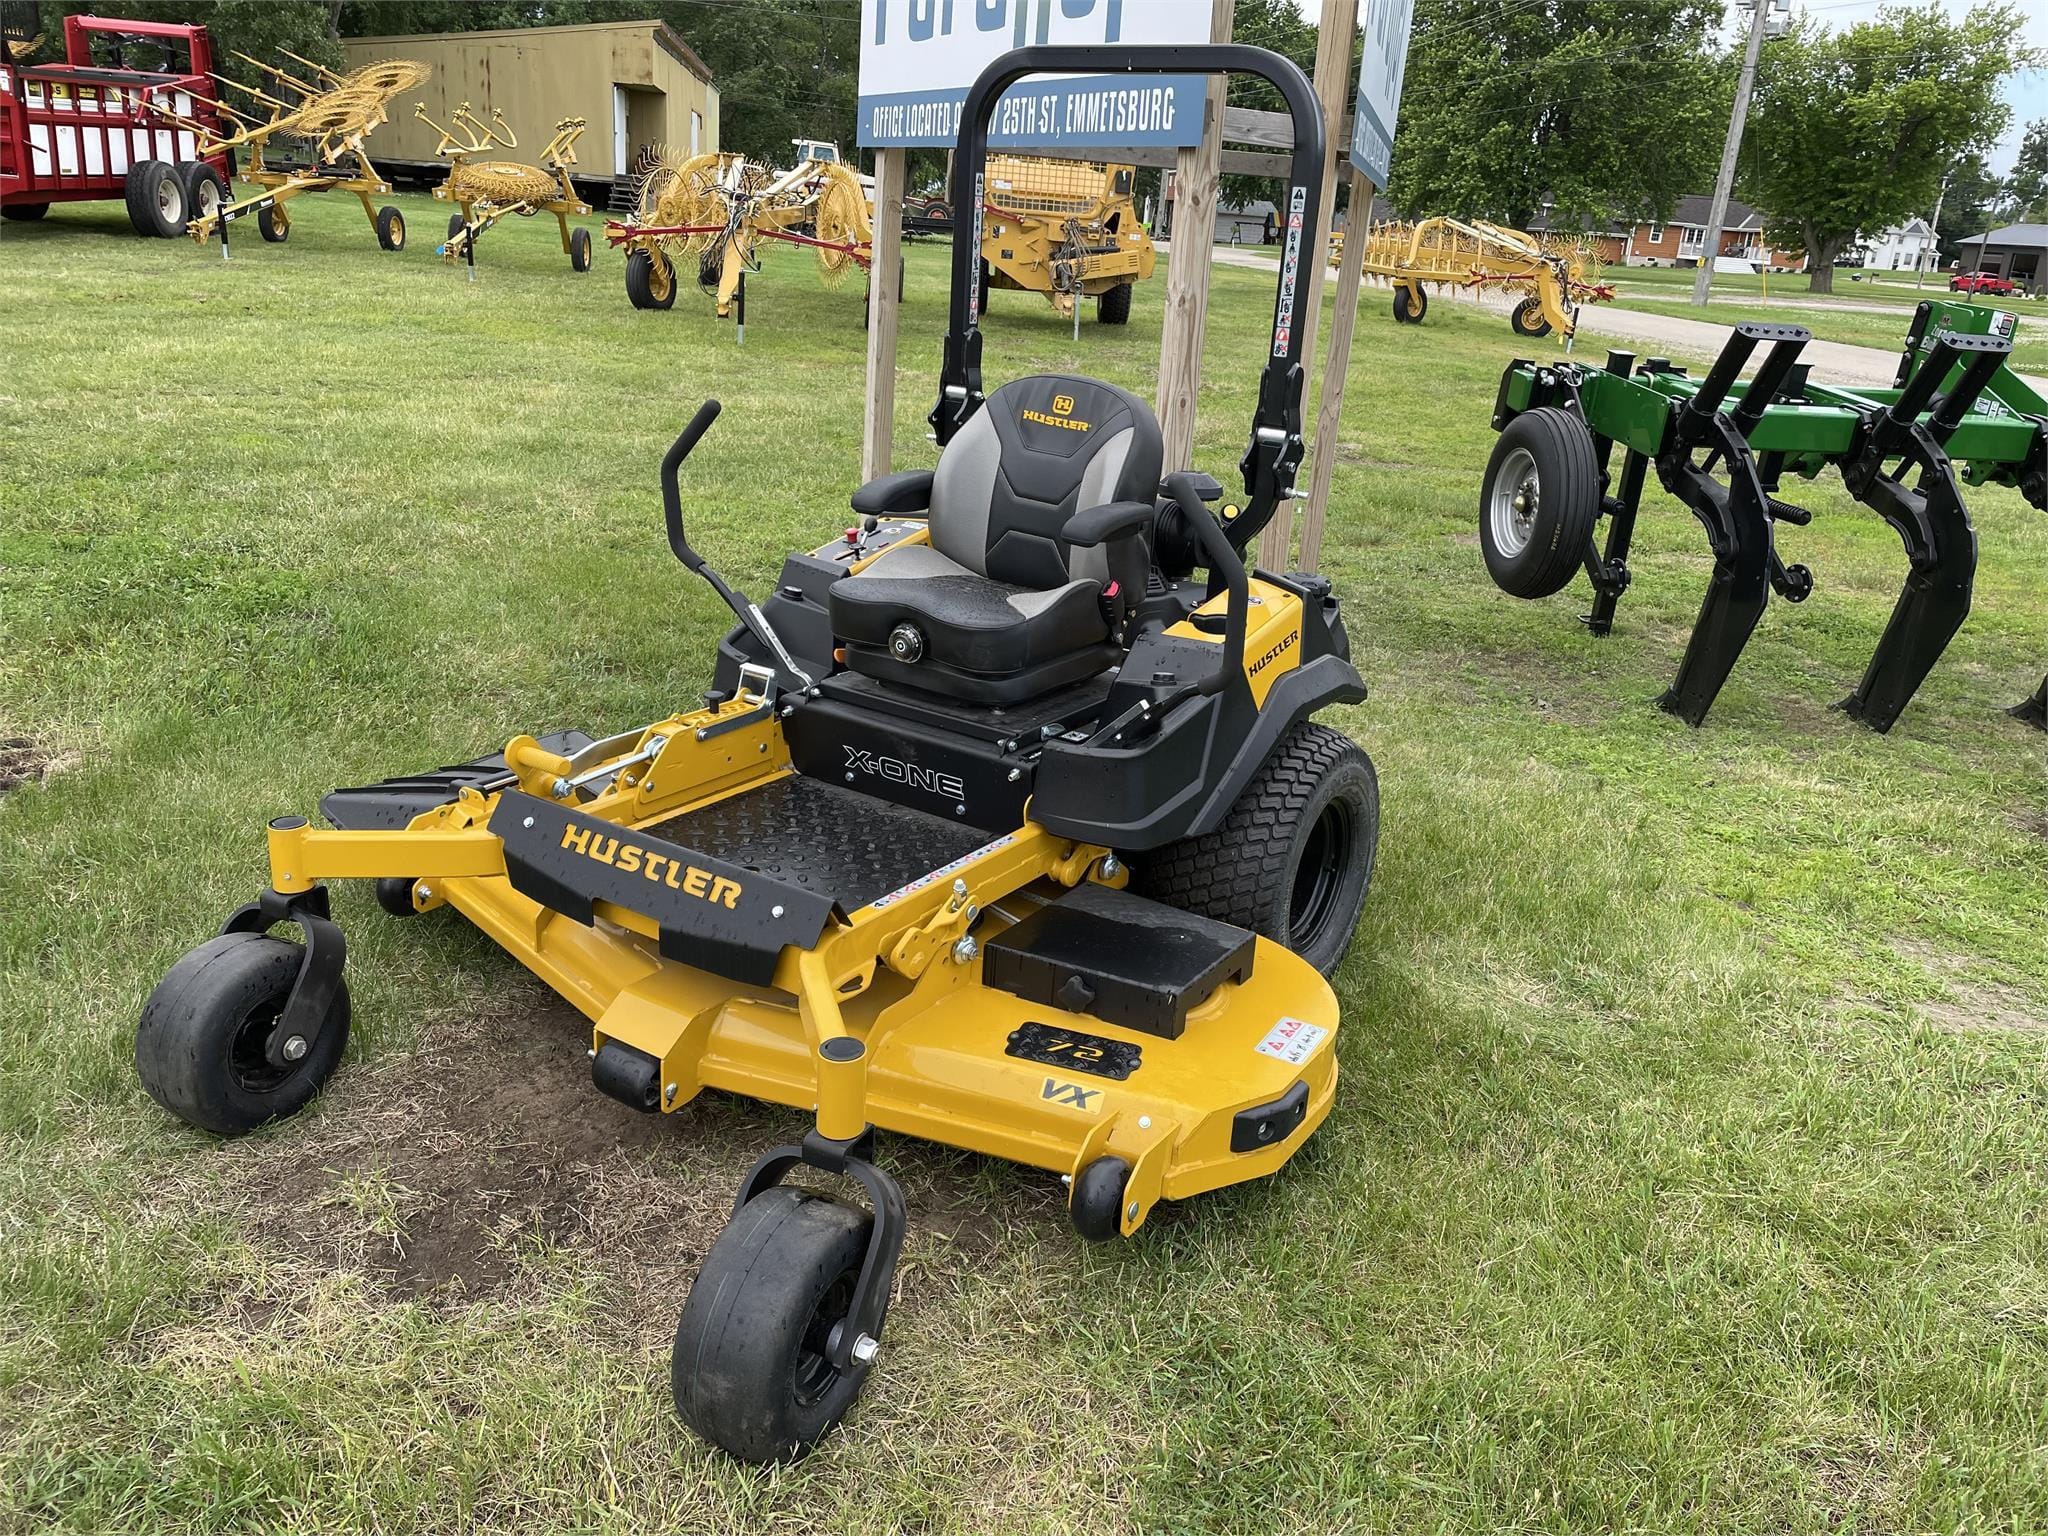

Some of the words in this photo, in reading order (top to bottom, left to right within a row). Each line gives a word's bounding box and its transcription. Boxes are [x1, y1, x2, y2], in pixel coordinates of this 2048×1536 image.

[872, 105, 904, 138] OFFICE
[905, 102, 950, 137] LOCATED
[1002, 97, 1035, 135] 25TH
[1038, 94, 1061, 139] ST,
[1065, 87, 1174, 133] EMMETSBURG
[1023, 409, 1089, 432] HUSTLER
[1248, 629, 1299, 678] HUSTLER
[842, 744, 964, 801] X-ONE
[560, 823, 742, 910] HUSTLER
[1046, 1039, 1104, 1063] 72
[1042, 1078, 1101, 1110] VX
